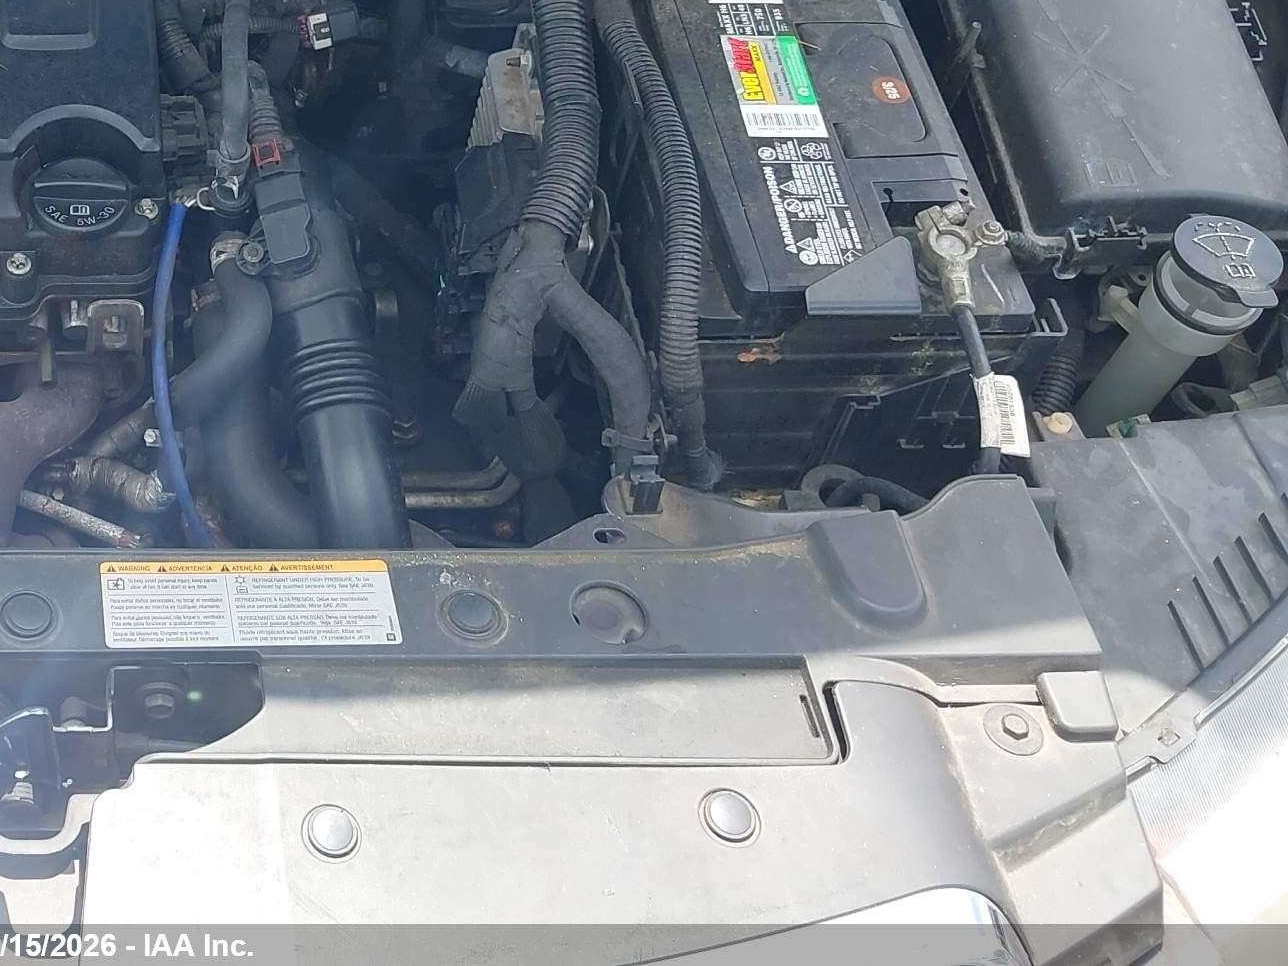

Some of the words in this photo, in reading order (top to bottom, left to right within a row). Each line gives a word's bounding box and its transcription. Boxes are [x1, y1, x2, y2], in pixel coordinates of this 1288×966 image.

[721, 15, 734, 34] MAXX
[44, 205, 69, 223] SAE
[76, 206, 116, 226] 5W-30
[762, 166, 796, 245] DANGER/POISON
